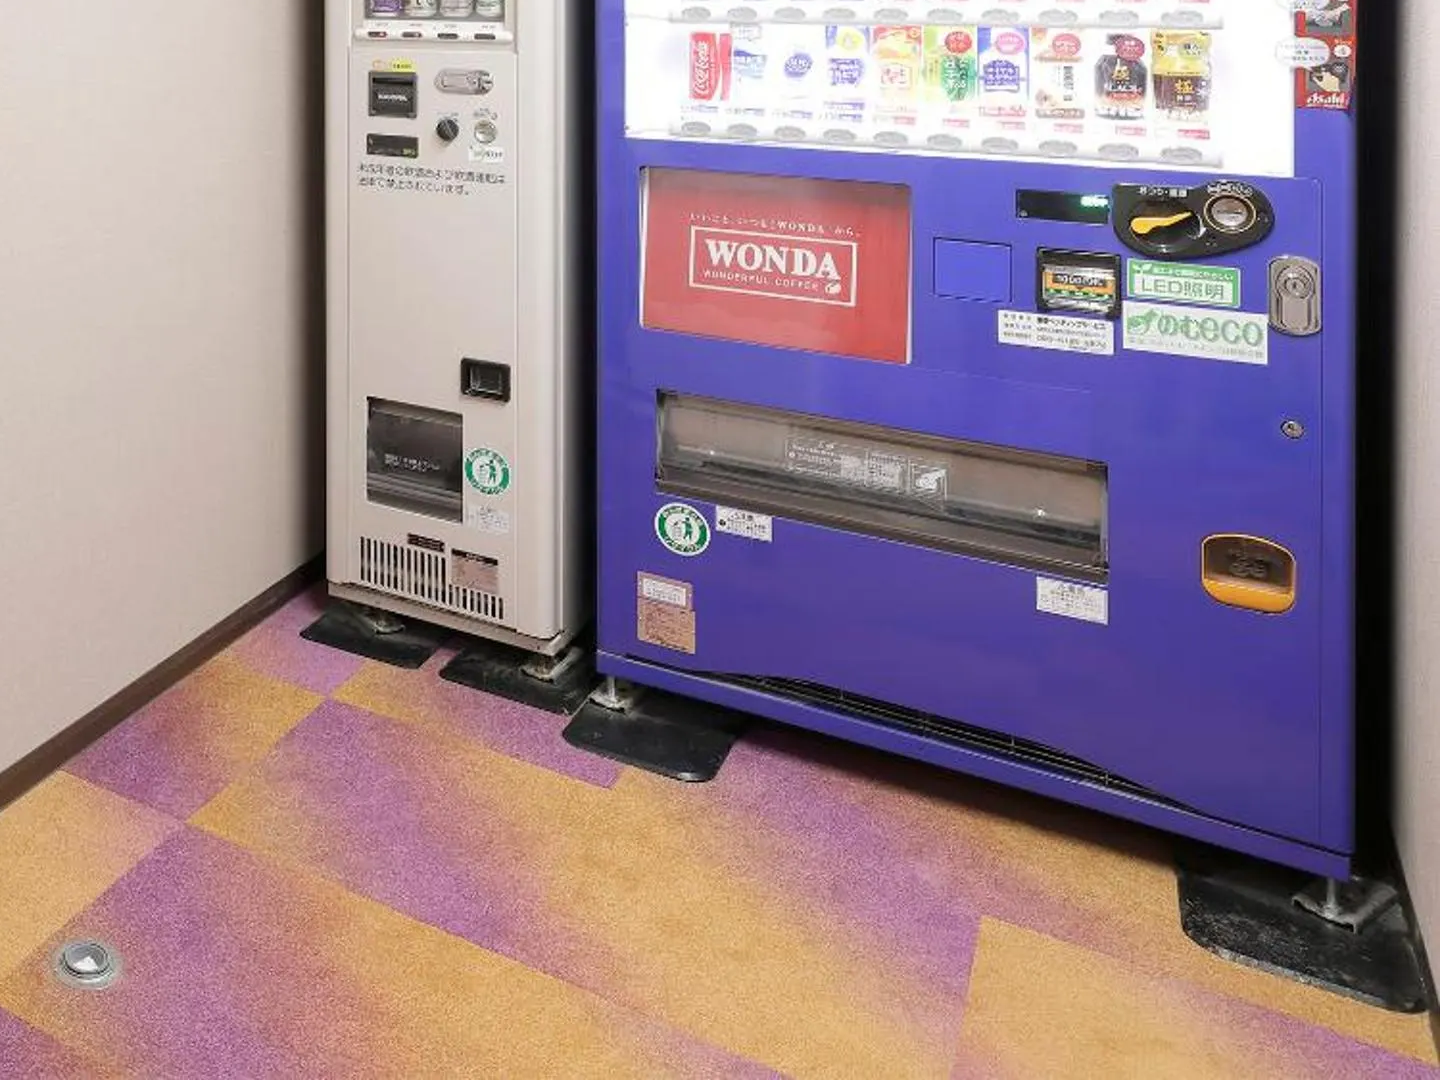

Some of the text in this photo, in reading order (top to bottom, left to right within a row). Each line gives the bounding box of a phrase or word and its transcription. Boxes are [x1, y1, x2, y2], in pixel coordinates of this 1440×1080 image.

[704, 238, 842, 280] WONDA
[702, 269, 771, 286] WONDERFUL
[1140, 276, 1226, 300] LED照明
